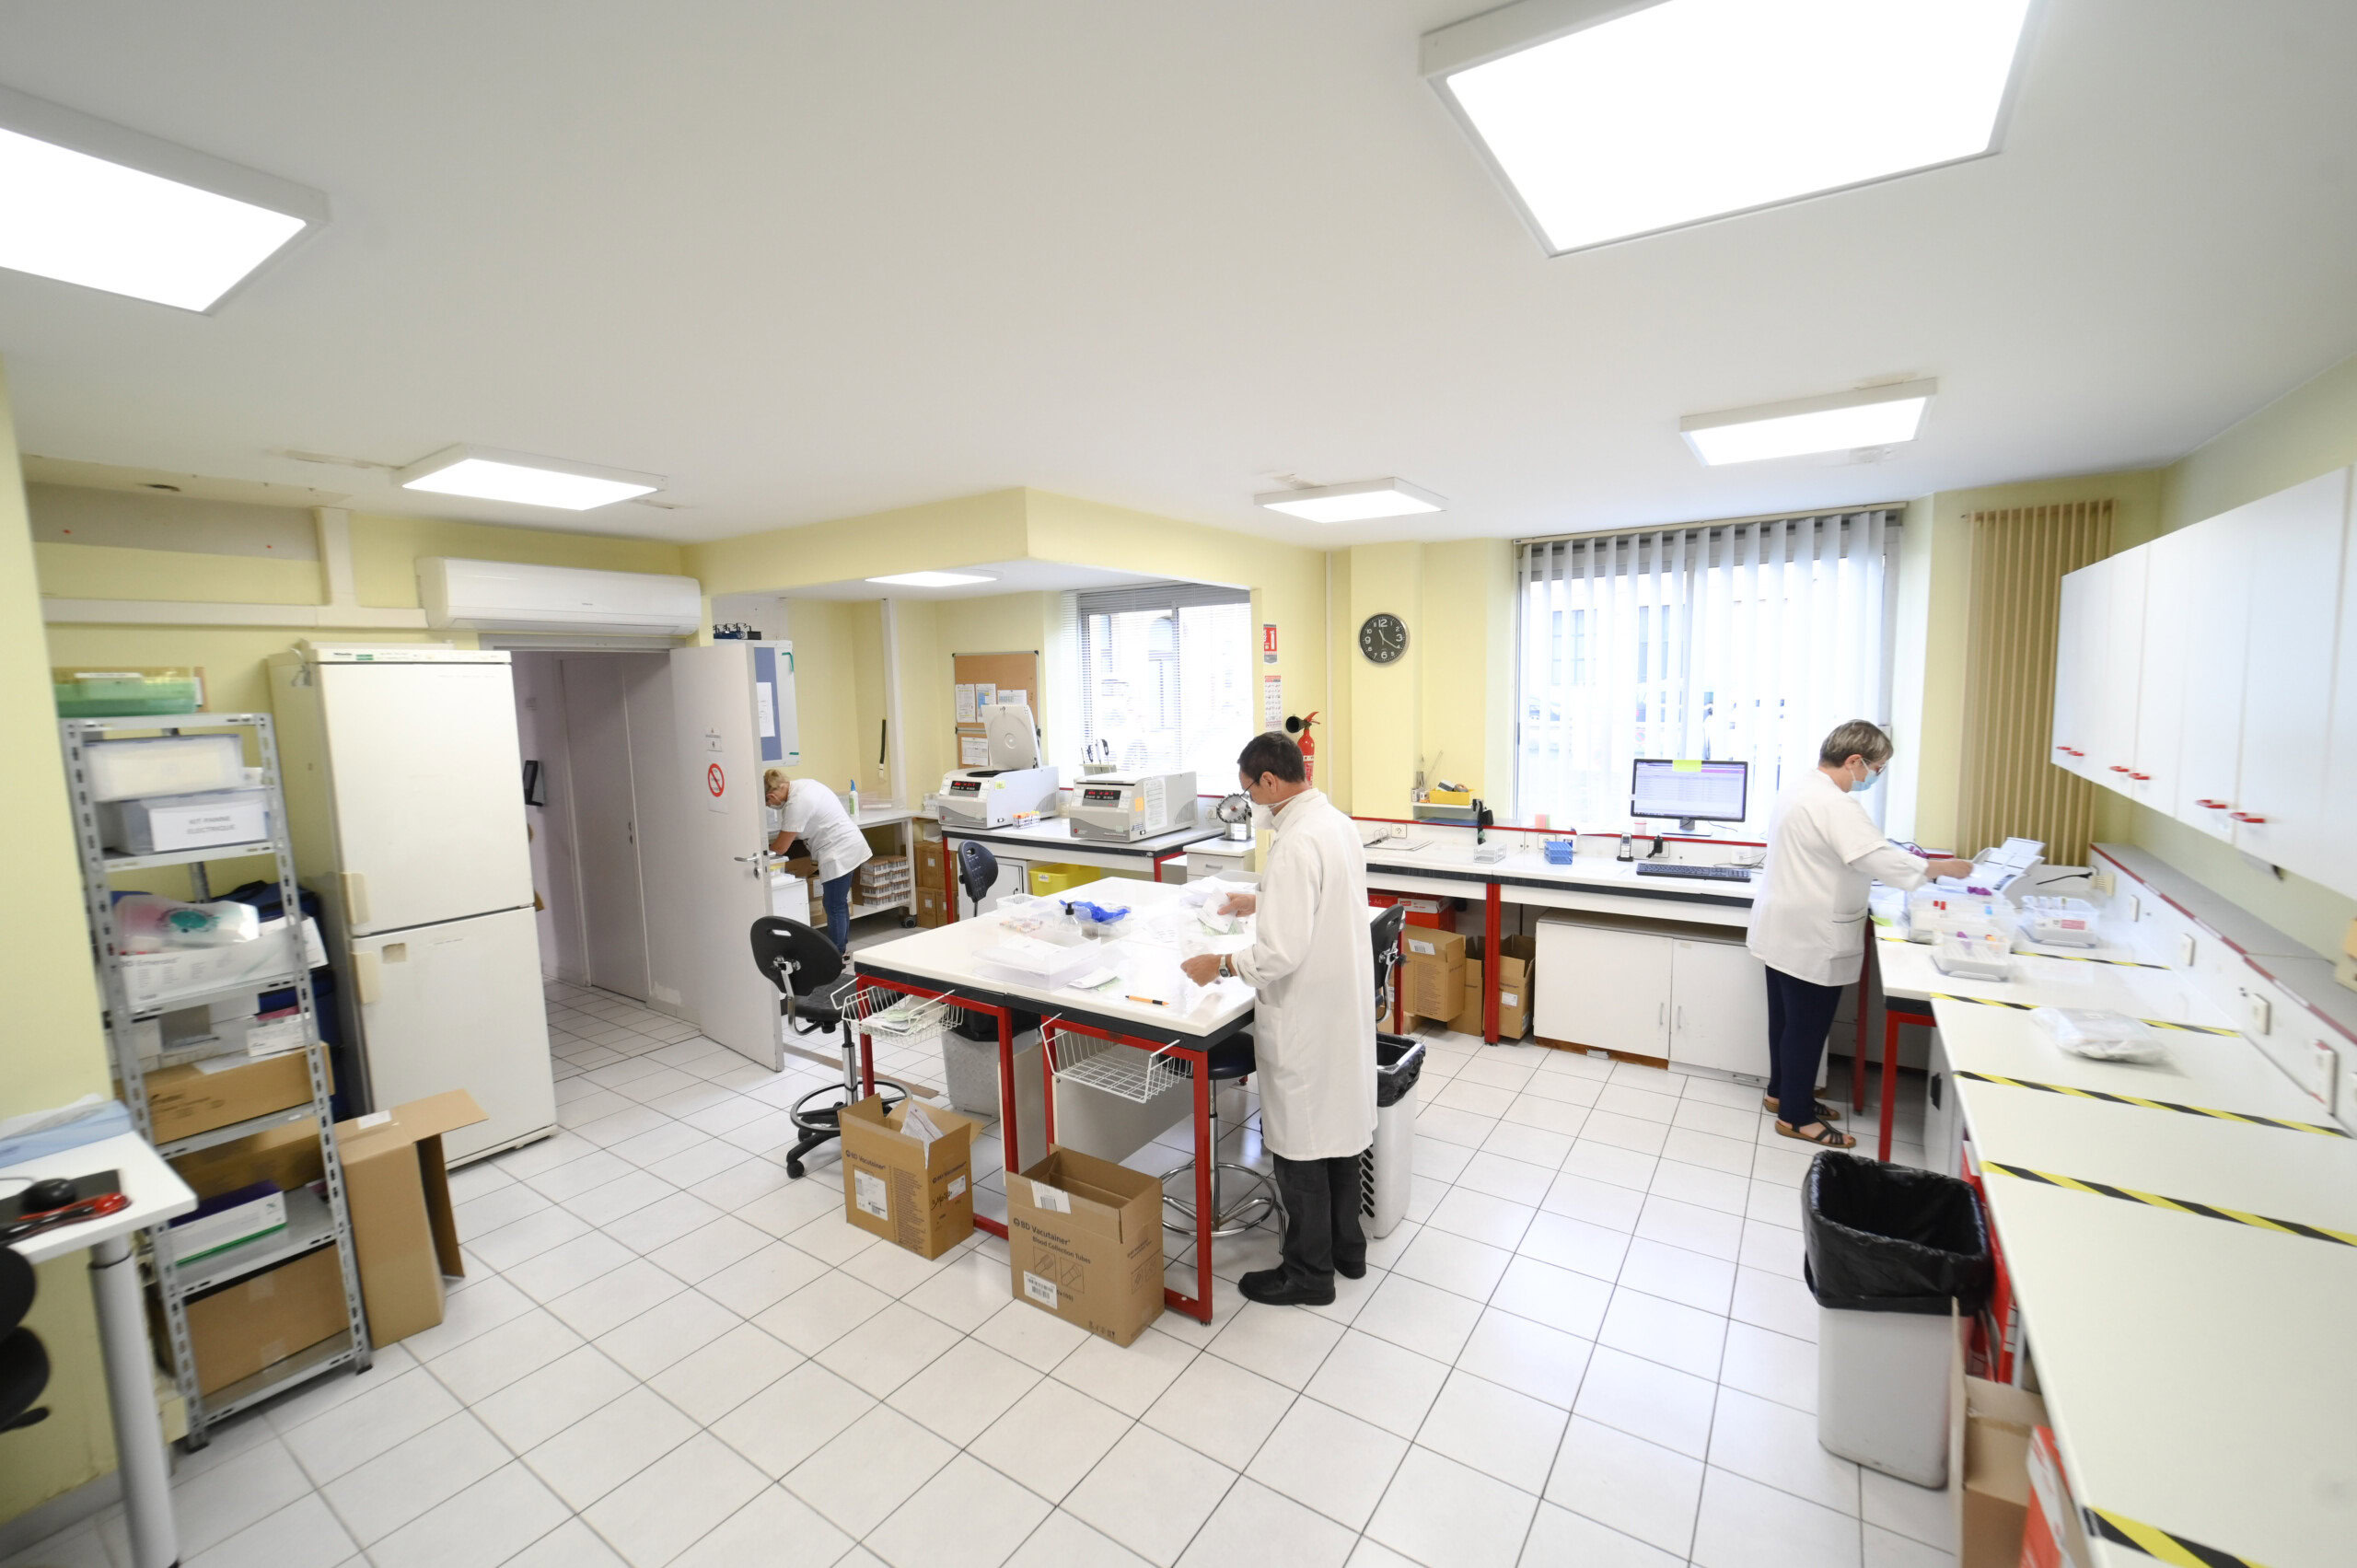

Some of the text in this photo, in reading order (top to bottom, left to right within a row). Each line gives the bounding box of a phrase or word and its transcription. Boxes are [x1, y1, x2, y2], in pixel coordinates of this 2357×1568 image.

[1378, 619, 1387, 628] 12
[1364, 636, 1371, 645] 9
[1395, 633, 1403, 642] 3
[1381, 651, 1387, 659] 6
[1020, 1220, 1030, 1231] BD
[1032, 1235, 1091, 1264] Blood Collection Tubes
